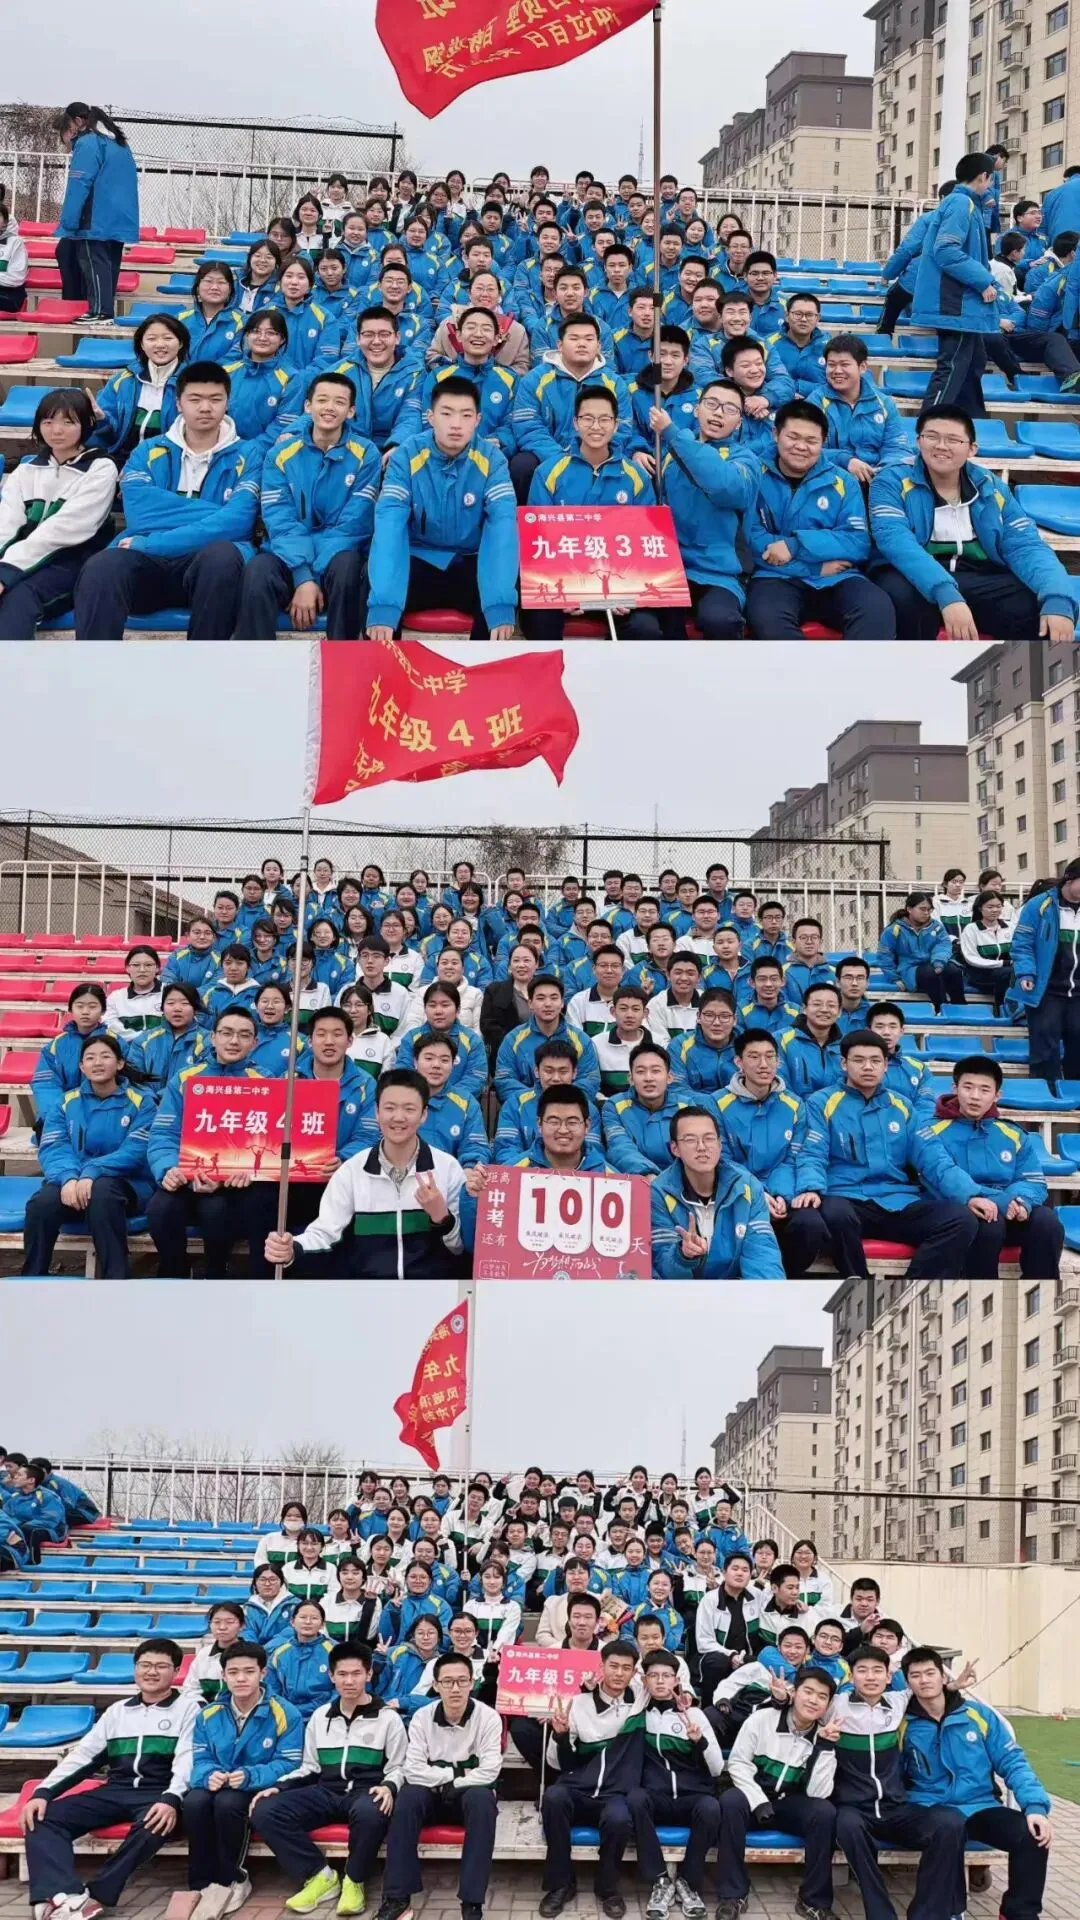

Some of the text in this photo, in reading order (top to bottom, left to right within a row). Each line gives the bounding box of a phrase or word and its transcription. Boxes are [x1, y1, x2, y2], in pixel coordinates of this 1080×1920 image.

[532, 535, 668, 559] 九年级3班
[205, 1085, 270, 1096] 海兴县第二中学
[194, 1108, 326, 1135] 九年级4班
[487, 1188, 506, 1228] 中考
[481, 1233, 508, 1247] 还有
[632, 1237, 648, 1255] 天
